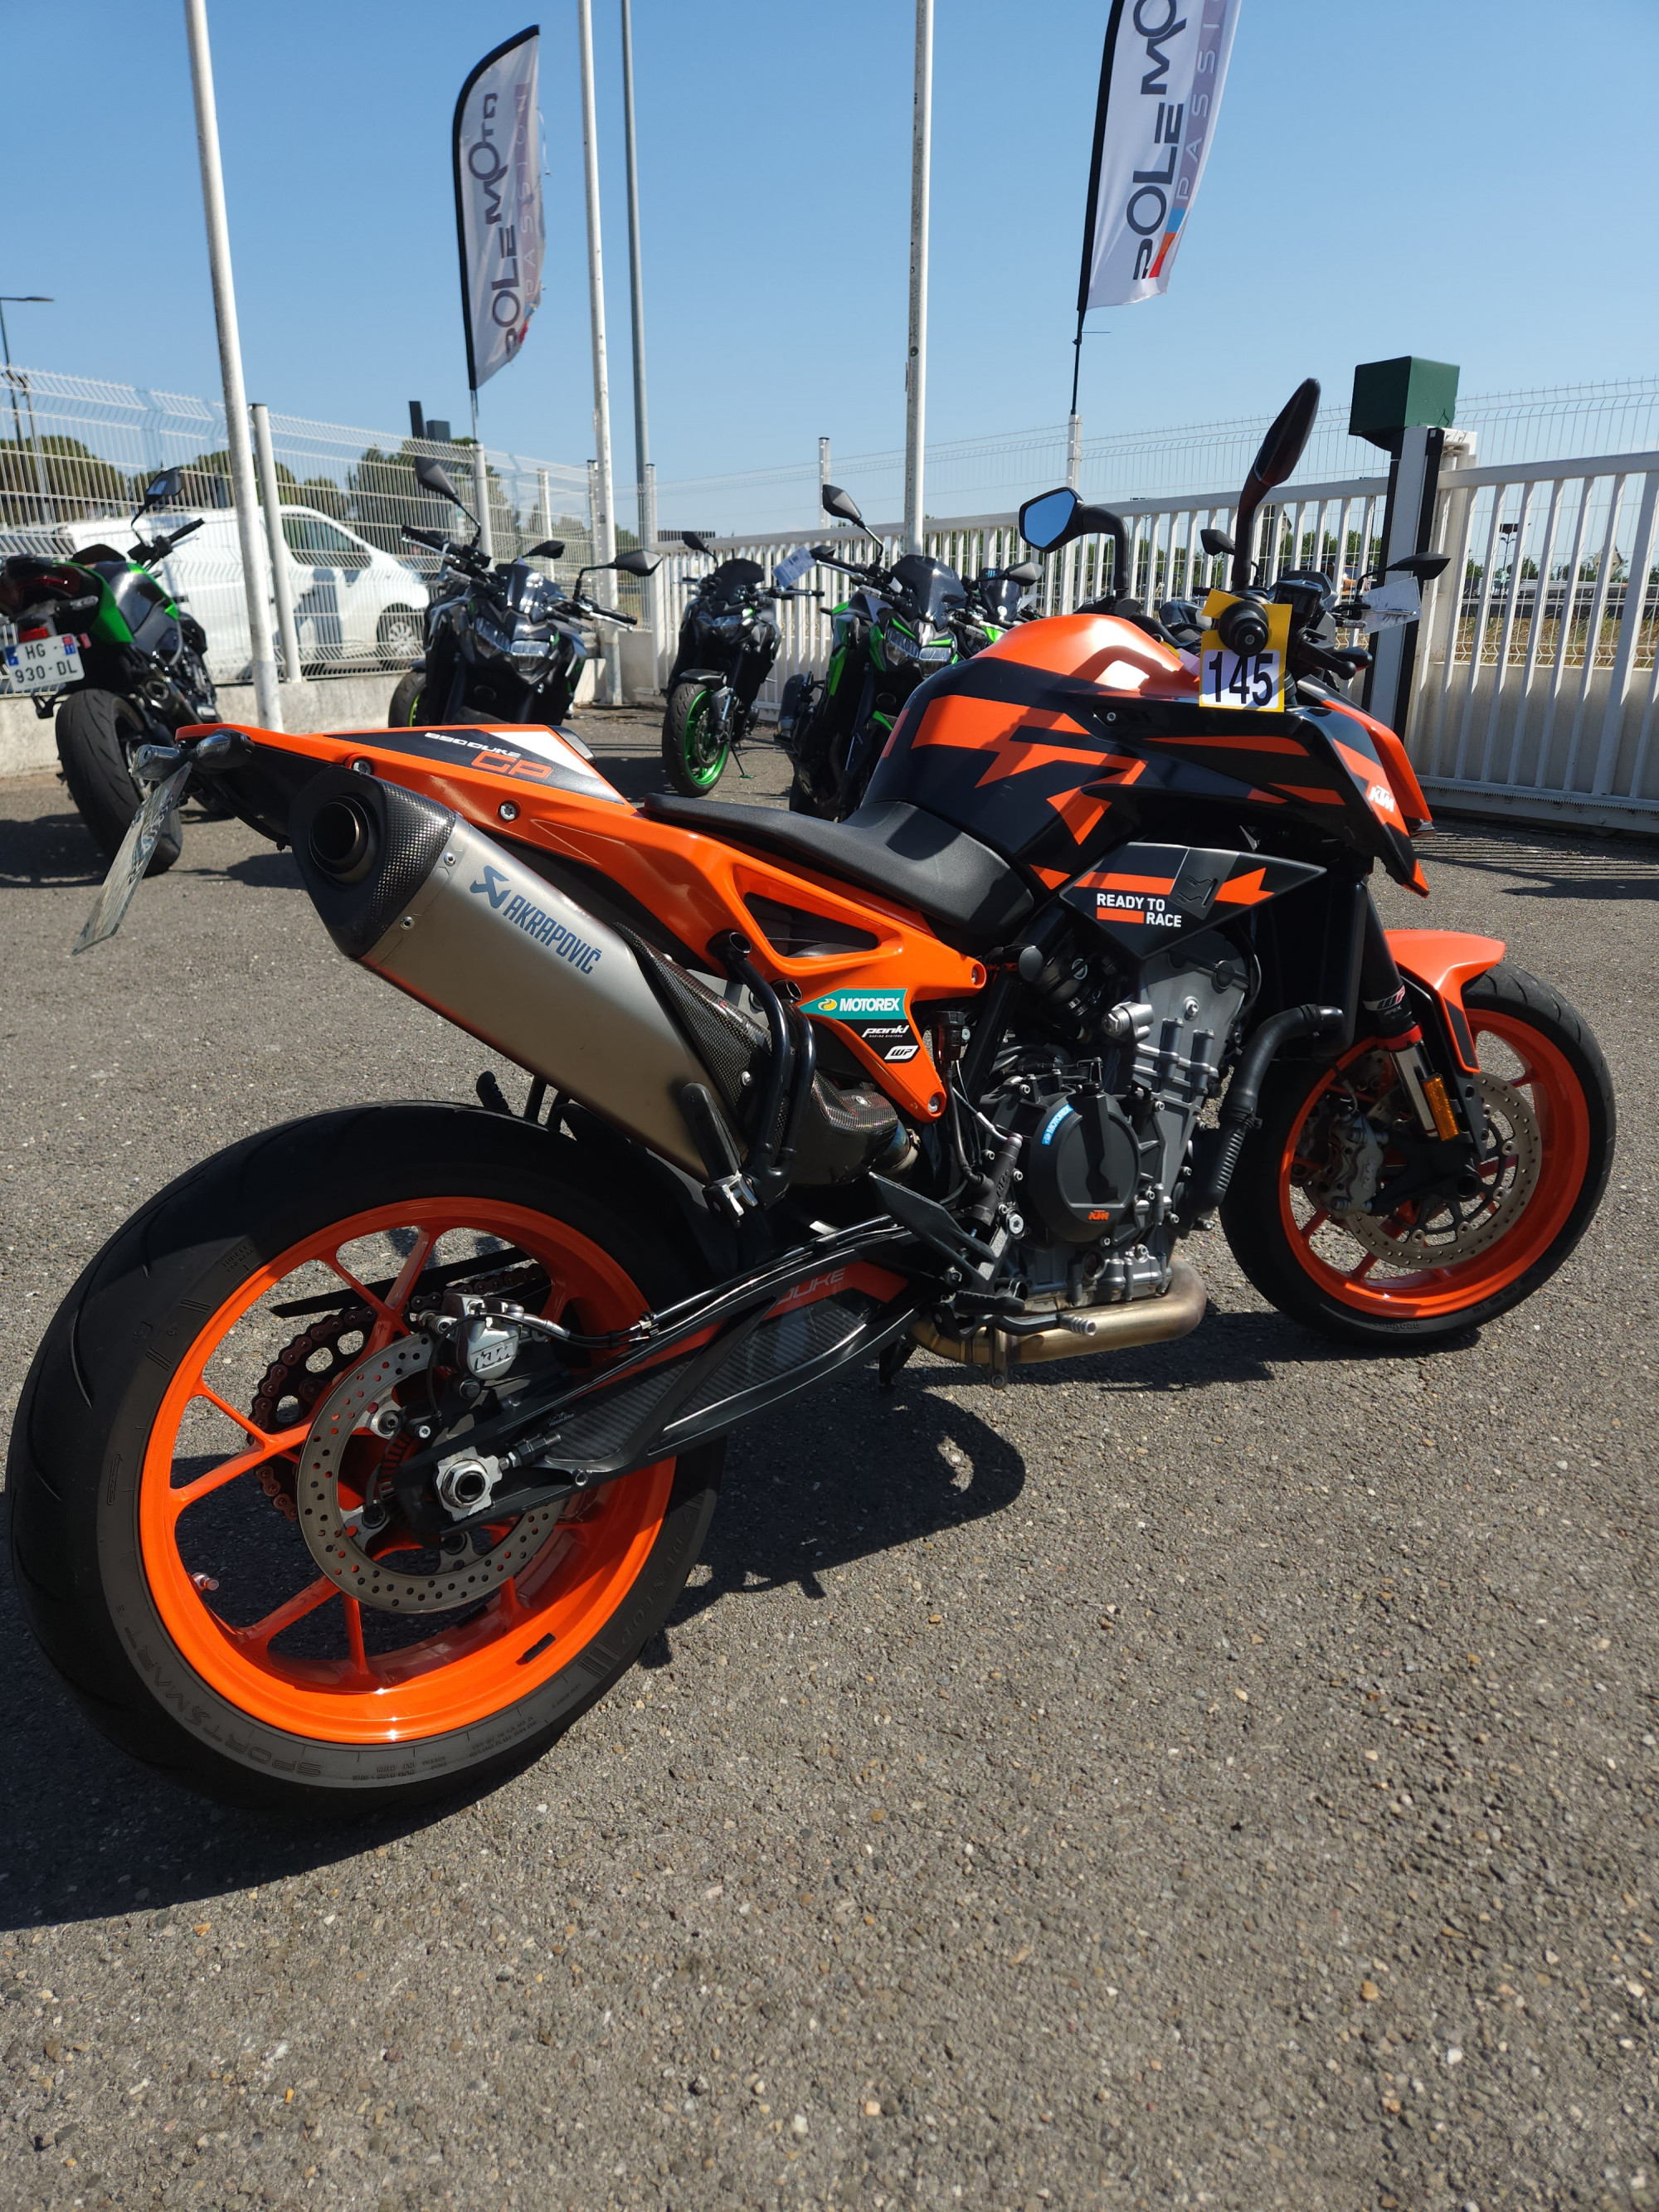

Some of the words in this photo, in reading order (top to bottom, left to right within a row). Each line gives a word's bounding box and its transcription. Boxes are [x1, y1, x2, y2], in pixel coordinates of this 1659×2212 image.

[1175, 0, 1220, 201] PASSI
[15, 660, 77, 683] 930-DL
[1209, 651, 1274, 706] 145
[467, 741, 522, 758] DUKE
[471, 751, 554, 779] GP
[1369, 785, 1394, 812] KTM
[1097, 892, 1145, 910] READY
[1147, 897, 1165, 912] TO
[1146, 912, 1182, 927] RACE
[839, 998, 900, 1012] MOTOREX
[861, 1025, 910, 1038] pankl
[1087, 1209, 1109, 1221] KTM
[476, 1342, 514, 1369] KTM
